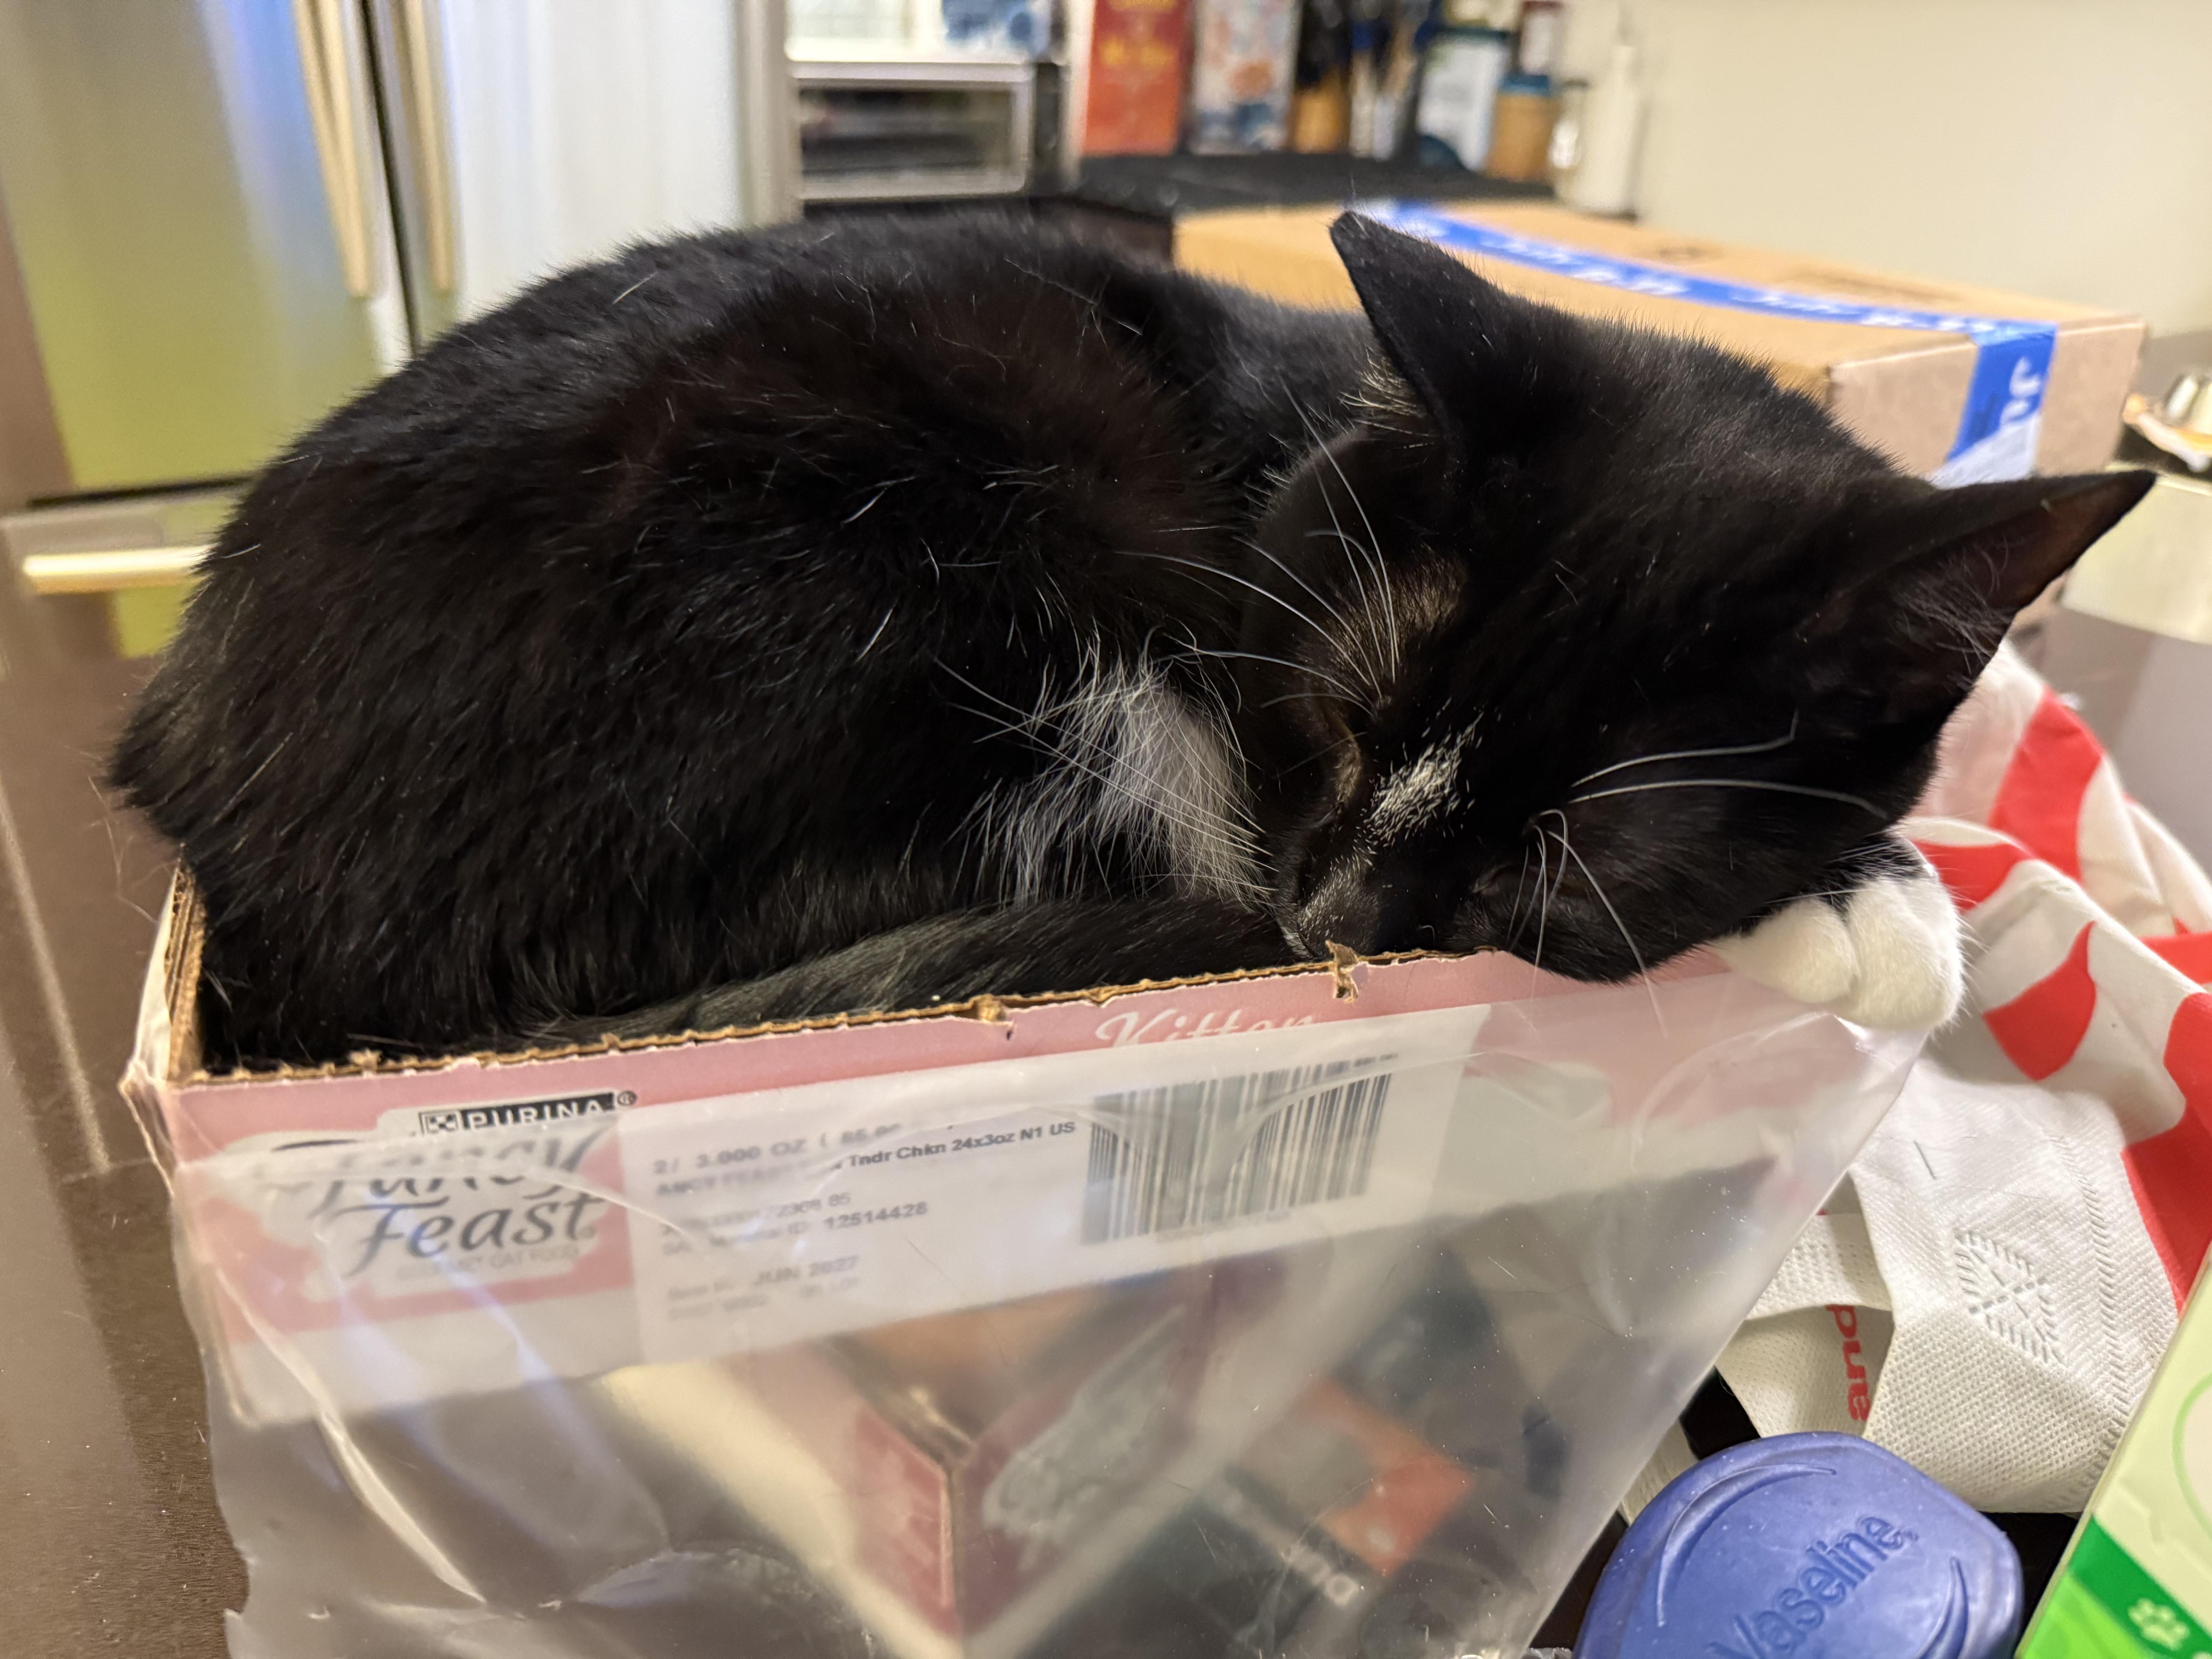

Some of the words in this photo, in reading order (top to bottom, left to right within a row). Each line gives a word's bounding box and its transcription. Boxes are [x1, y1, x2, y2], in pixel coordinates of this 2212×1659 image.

[467, 1098, 605, 1129] PURINA
[849, 1150, 893, 1167] Tndr
[896, 1143, 947, 1159] Chkn
[951, 1133, 1015, 1152] 24x3oz
[1020, 1126, 1043, 1140] N1
[1049, 1121, 1076, 1136] US
[326, 1191, 607, 1279] Feast
[823, 1202, 928, 1230] 12514428
[1709, 1516, 1904, 1659] Vaseline
